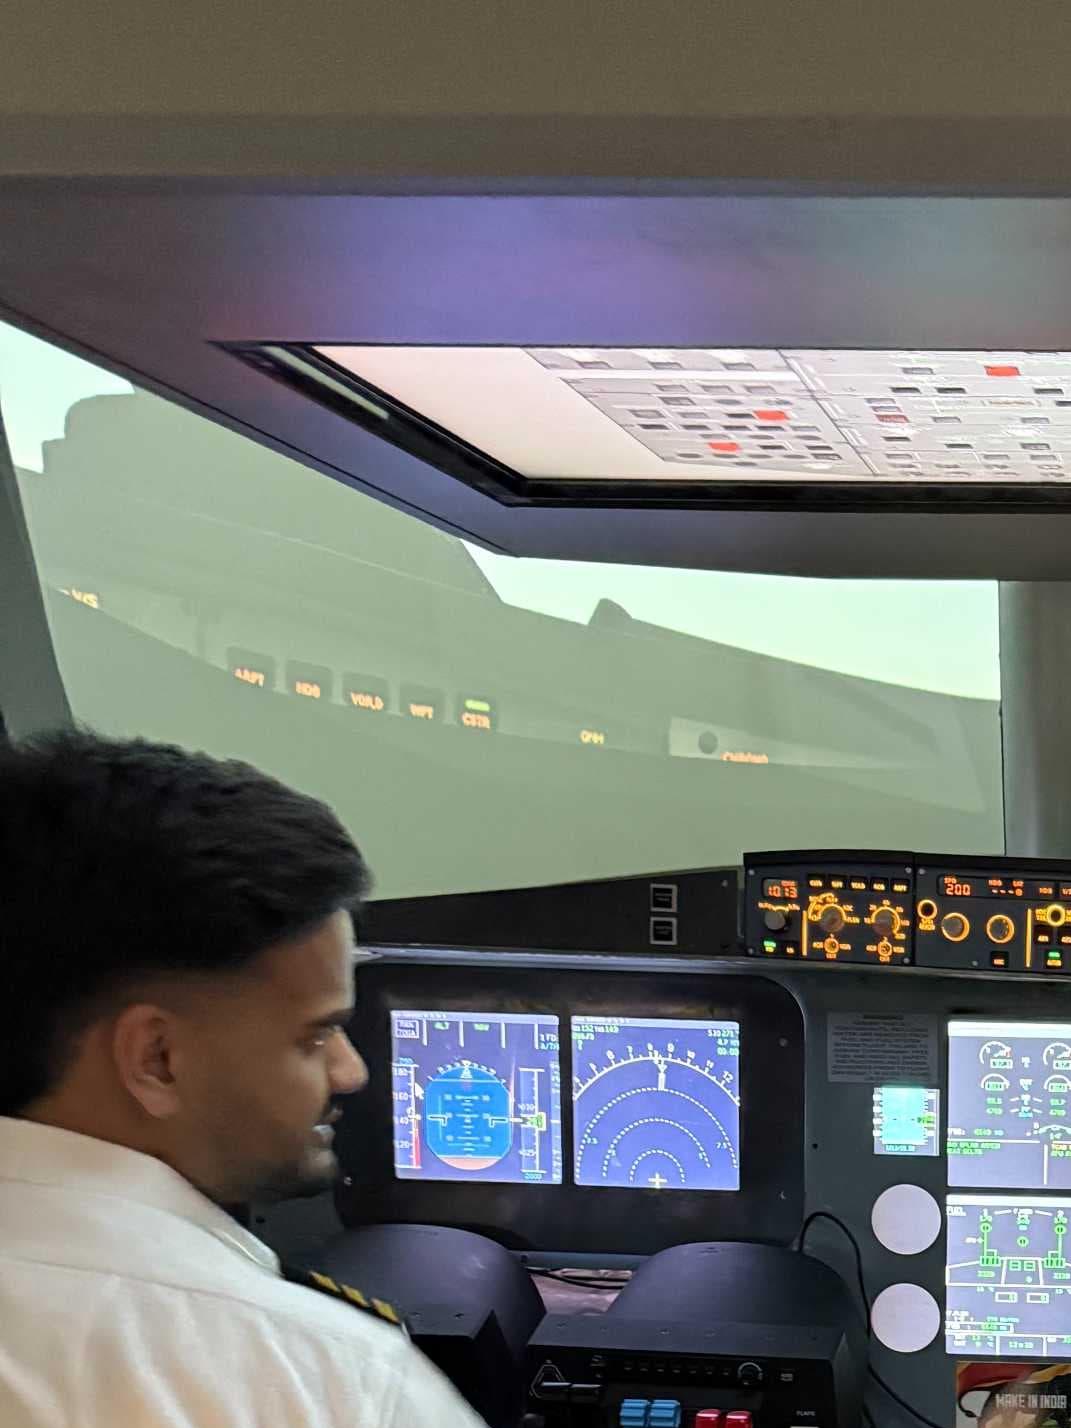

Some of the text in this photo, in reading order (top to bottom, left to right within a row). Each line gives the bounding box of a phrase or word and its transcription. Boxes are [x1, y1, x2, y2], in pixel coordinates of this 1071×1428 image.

[946, 883, 971, 896] 200
[995, 1393, 1068, 1408] MAKE IN INDIA
